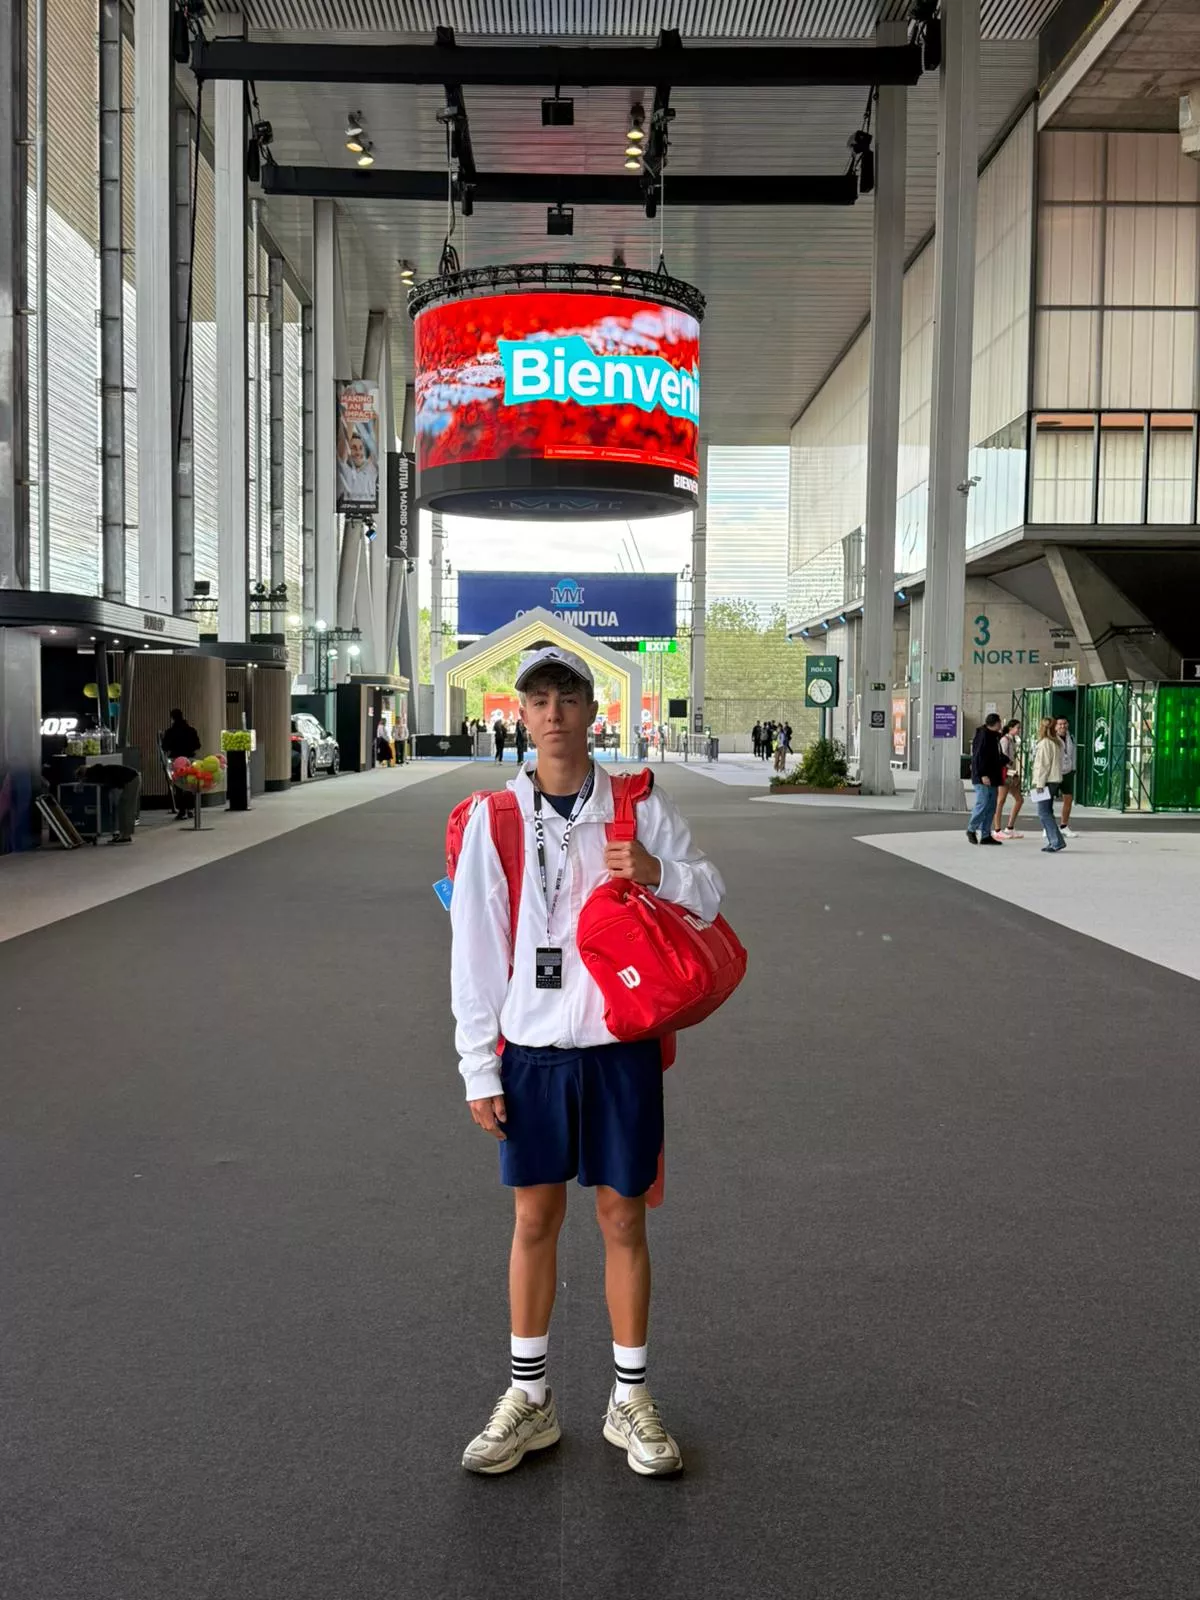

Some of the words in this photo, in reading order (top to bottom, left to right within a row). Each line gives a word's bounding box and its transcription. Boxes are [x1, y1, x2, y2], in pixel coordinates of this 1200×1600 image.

[345, 410, 375, 418] IMPACT
[399, 457, 409, 490] MUTUA
[400, 491, 408, 526] MADRID
[399, 527, 408, 553] OPEN
[973, 615, 991, 646] 3
[645, 641, 669, 652] EXIT
[973, 650, 1040, 664] NORTE
